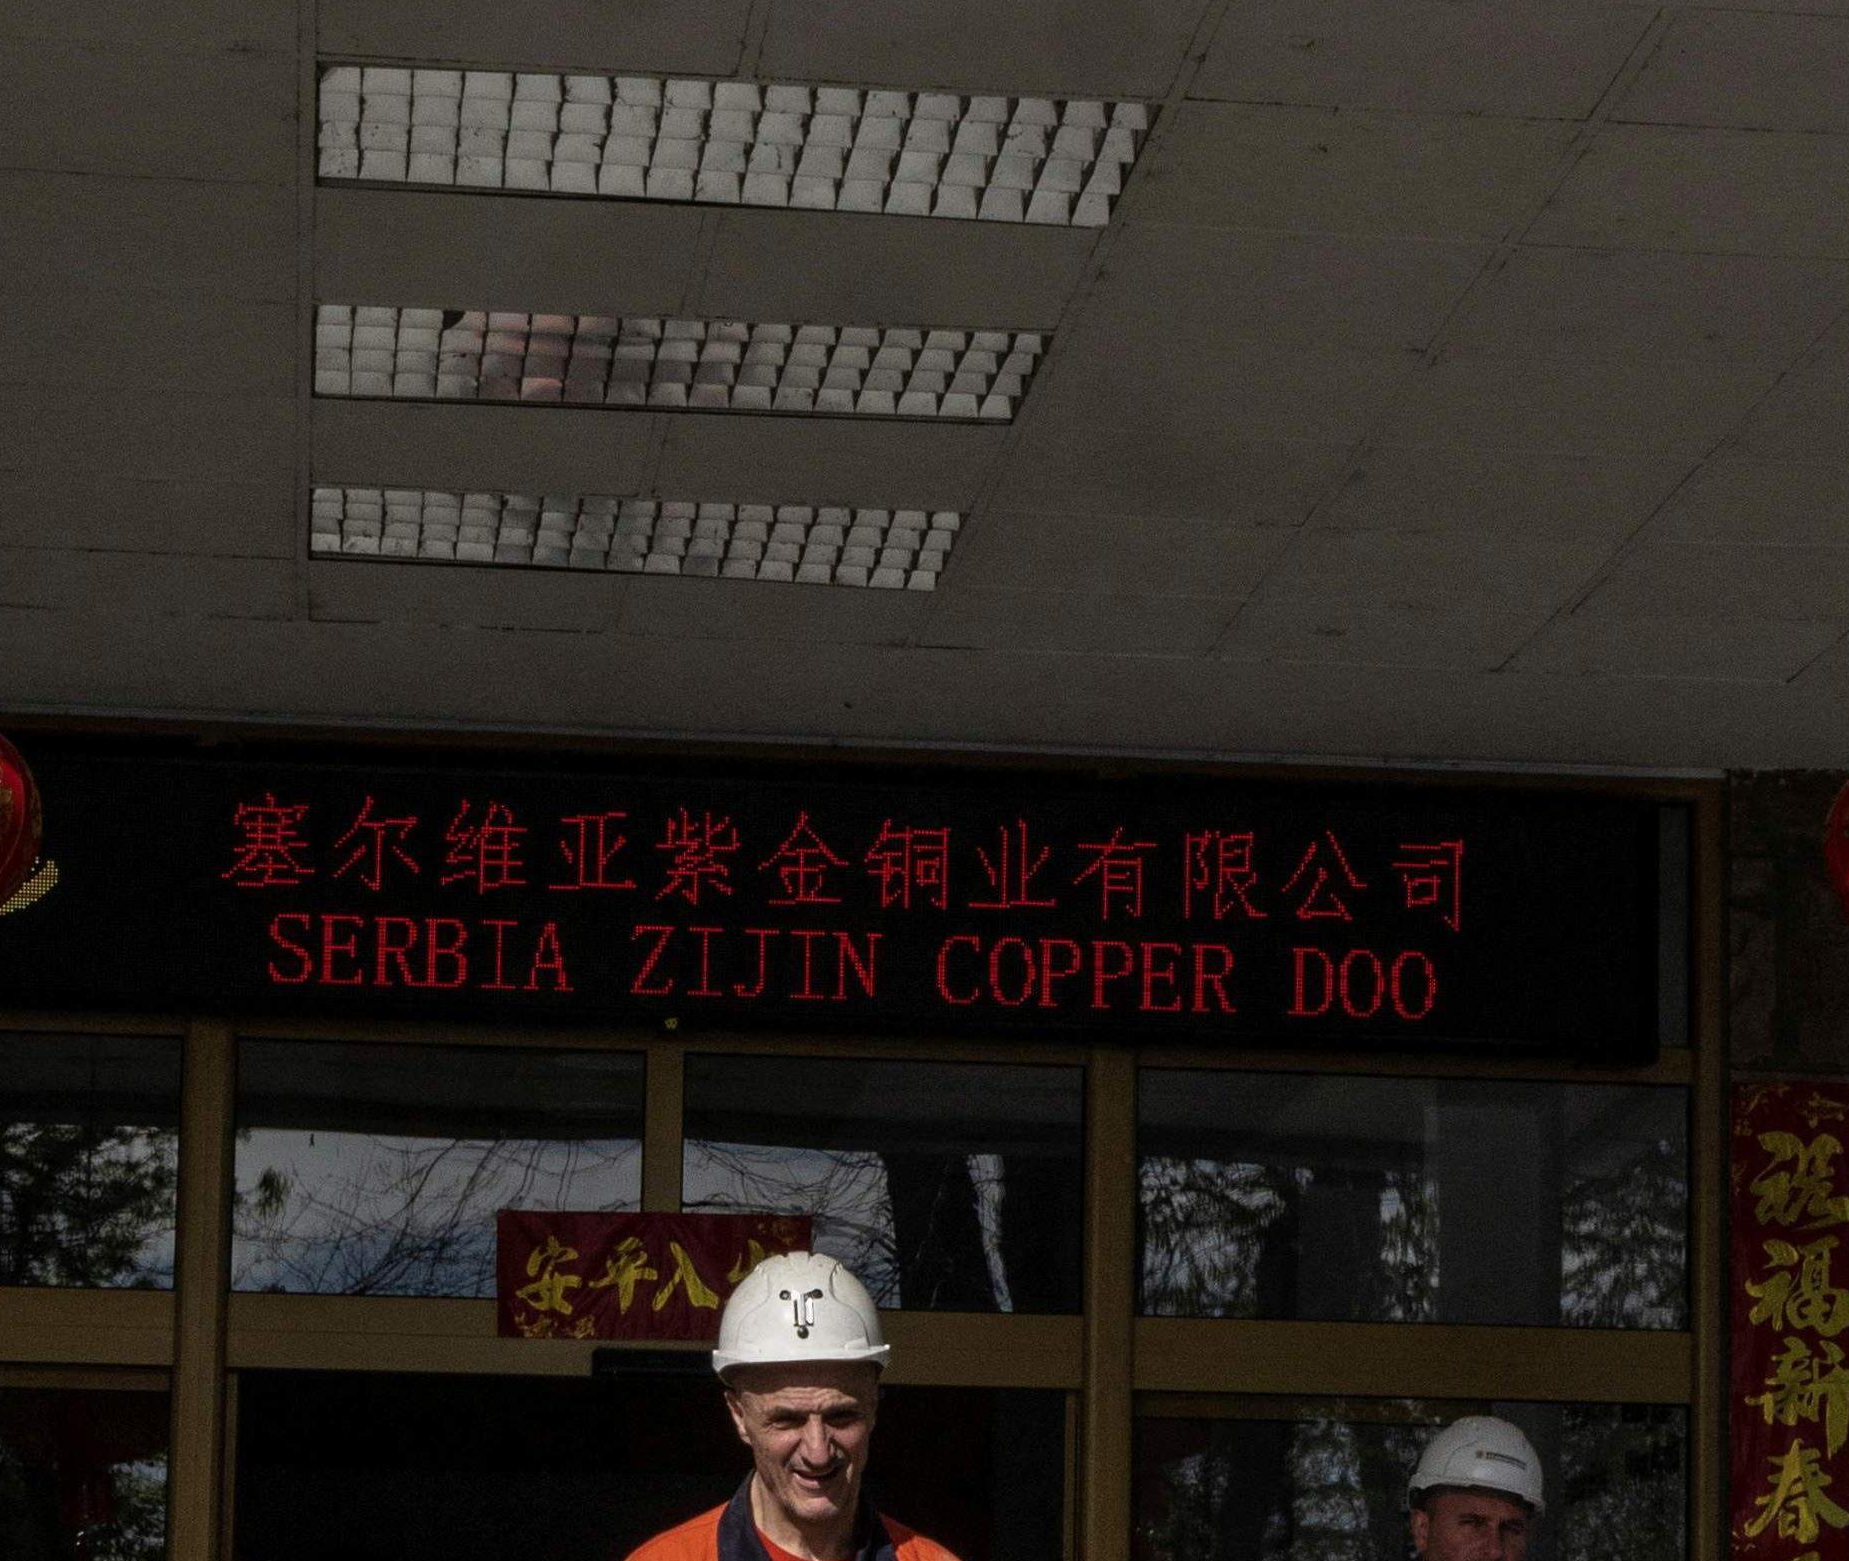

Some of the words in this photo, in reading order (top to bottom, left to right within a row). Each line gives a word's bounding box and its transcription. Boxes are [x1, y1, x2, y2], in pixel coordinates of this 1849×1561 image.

[220, 793, 1464, 931] 塞尔维亚紫金铜业有限公司
[267, 913, 575, 992] SERBIA
[630, 923, 882, 1001] ZIJIN
[936, 935, 1237, 1014] COPPER
[1287, 946, 1437, 1020] DOO
